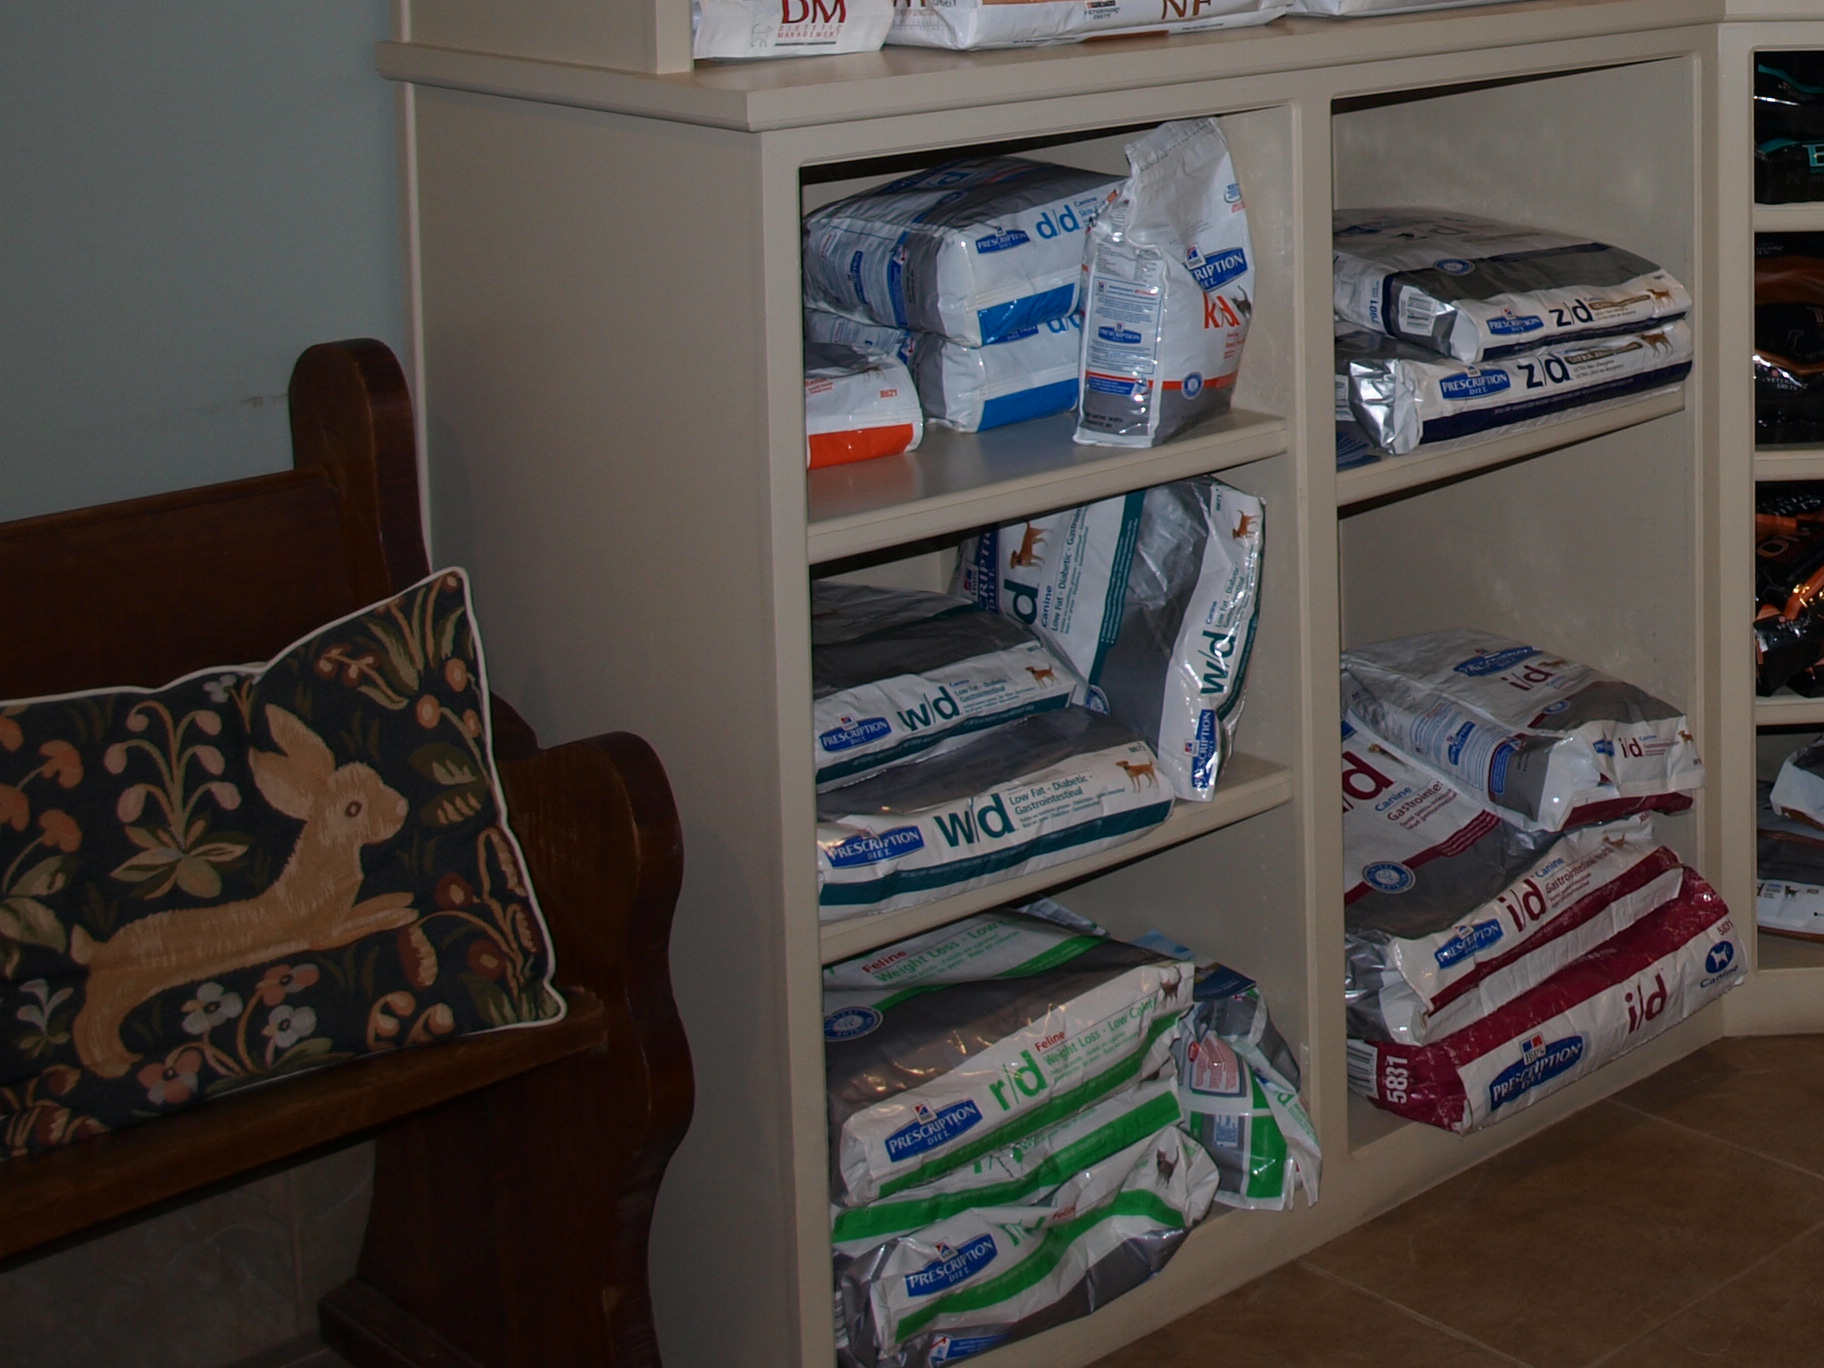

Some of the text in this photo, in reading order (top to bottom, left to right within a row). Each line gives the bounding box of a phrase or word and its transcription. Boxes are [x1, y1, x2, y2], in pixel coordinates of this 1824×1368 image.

[1036, 204, 1081, 240] d/d
[976, 230, 1030, 250] PRESCRIPTION
[1370, 299, 1380, 325] 7901
[1549, 298, 1594, 328] z/d
[1442, 373, 1508, 394] PRESCRIPTION
[1040, 584, 1052, 628] Canine
[1051, 551, 1072, 632] Low Fat Diabetic
[1198, 630, 1238, 696] w/d
[1500, 664, 1554, 692] i/d
[896, 684, 960, 732] w/d
[822, 721, 889, 748] PRESCRIPTION
[1618, 736, 1643, 760] i/d
[1008, 772, 1088, 806] Low Fat Diabetic
[1014, 787, 1084, 817] Gastrointestinal
[1374, 785, 1413, 814] Canine
[933, 792, 1018, 848] w/d
[830, 828, 920, 860] PRESCRIPTION
[868, 848, 893, 860] DIET
[1534, 856, 1564, 878] Canine
[1545, 856, 1599, 894] Gastrointestinal
[1496, 878, 1547, 933] i/d
[862, 950, 909, 974] Feline
[874, 921, 999, 983] Weight Loss Low
[1700, 964, 1739, 988] Canine
[1624, 972, 1667, 1035] i/d
[1034, 1030, 1066, 1053] Feline
[1042, 1015, 1128, 1066] Weight Loss Low
[988, 1049, 1049, 1112] r/d
[1386, 1054, 1409, 1104] 5831
[888, 1103, 978, 1154] PRESCRIPTION
[926, 1130, 952, 1147] DIET
[907, 1237, 993, 1290] PRESCRIPTION
[948, 1266, 970, 1284] DIET
